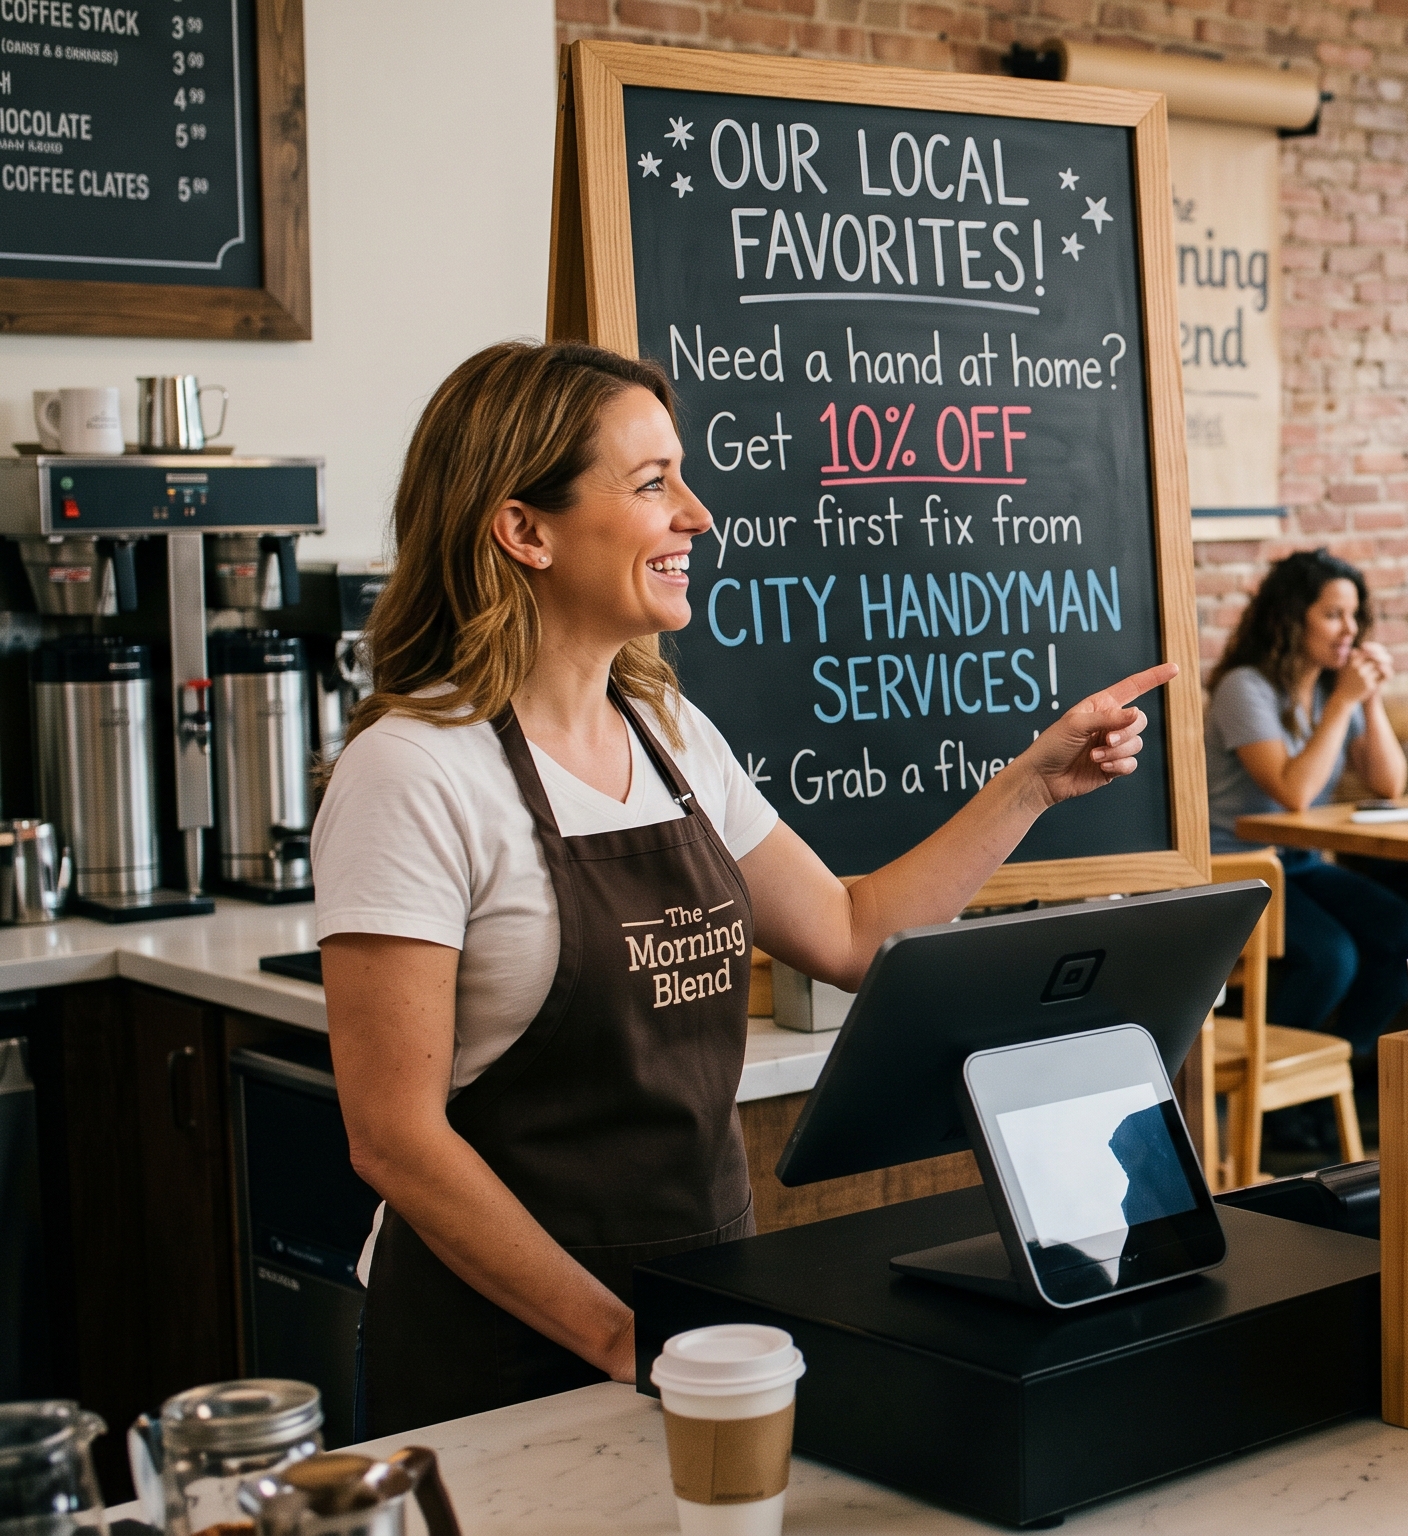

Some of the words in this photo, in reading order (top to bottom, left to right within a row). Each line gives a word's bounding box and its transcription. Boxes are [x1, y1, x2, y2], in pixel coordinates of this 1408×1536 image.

[1, 0, 74, 28] COFFEE
[78, 4, 139, 36] STACK
[2, 164, 75, 195] COFFEE
[79, 169, 149, 200] CLATES
[710, 118, 828, 194] OUR
[857, 128, 1029, 206] LOCAL
[731, 207, 1045, 296] FAVORITES!
[670, 324, 785, 382] Need
[805, 350, 833, 382] a
[846, 327, 943, 386] hand
[959, 331, 998, 386] at
[1011, 332, 1126, 390] home?
[706, 410, 793, 471] Get
[819, 402, 916, 472] 10%
[936, 405, 1032, 473] OFF
[710, 514, 798, 569] your
[813, 494, 904, 547] first
[920, 494, 975, 547] fix
[992, 495, 1082, 546] from
[708, 574, 837, 648] CITY
[859, 565, 1122, 643] HANDYMAN
[812, 643, 1061, 725] SERVICES!
[790, 747, 887, 805] Grab
[902, 763, 925, 794] a
[934, 730, 1040, 792] flye
[624, 919, 746, 972] Morning
[665, 906, 703, 928] The
[652, 957, 733, 1009] Blend
